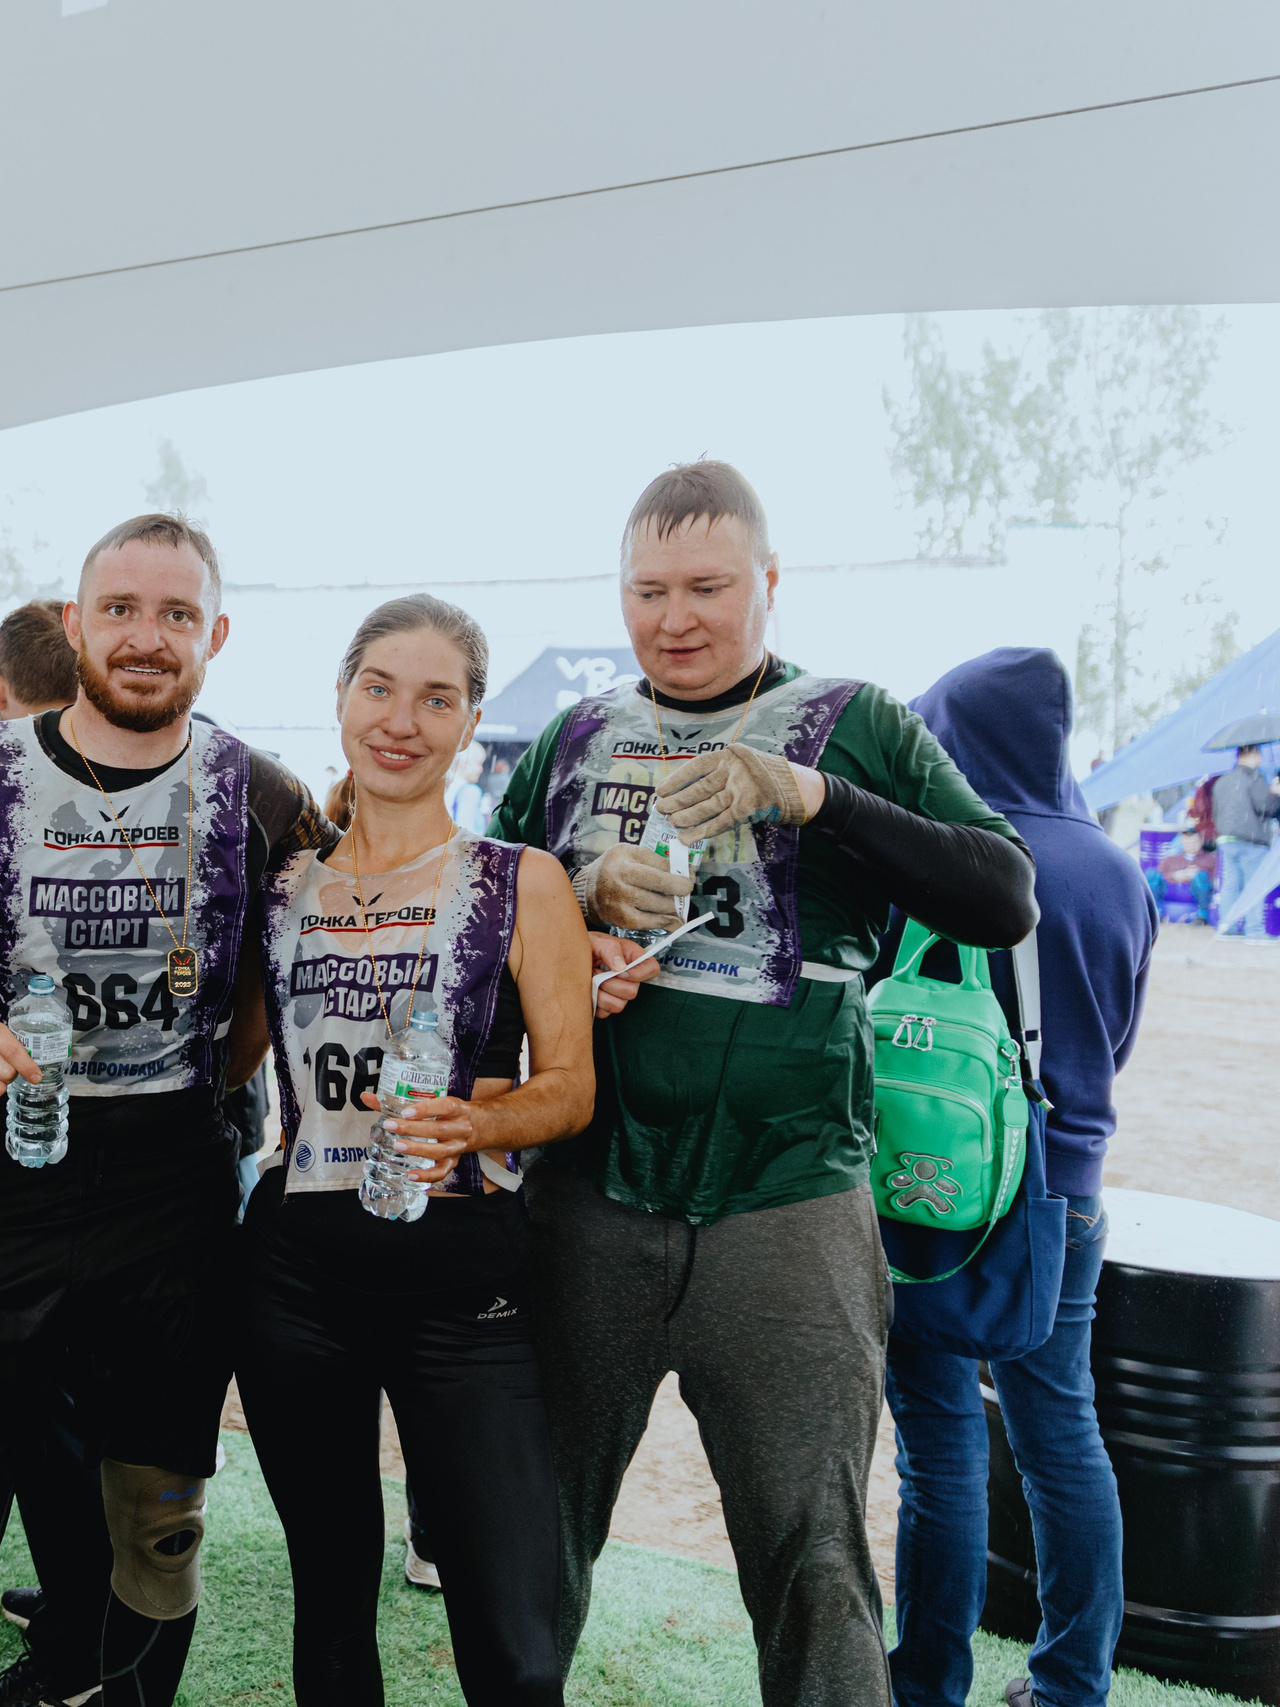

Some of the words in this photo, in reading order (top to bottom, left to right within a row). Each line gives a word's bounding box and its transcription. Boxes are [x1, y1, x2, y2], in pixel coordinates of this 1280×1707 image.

[613, 741, 669, 756] ГОНКА
[44, 828, 105, 845] ГОНКА
[110, 826, 180, 843] ГЕРОЕВ
[35, 867, 180, 913] МАССОВЫЙ
[300, 915, 357, 930] ГОНКА
[365, 906, 437, 925] ГЕРОЕВ
[70, 918, 143, 946] СТАРТ
[295, 947, 432, 990] МАССОВЫЙ
[31, 969, 180, 1032] 664
[324, 986, 392, 1018] СТАРТ
[401, 1069, 448, 1087] СЕНЕЖСКАЯ
[476, 1308, 518, 1320] DEMIX
